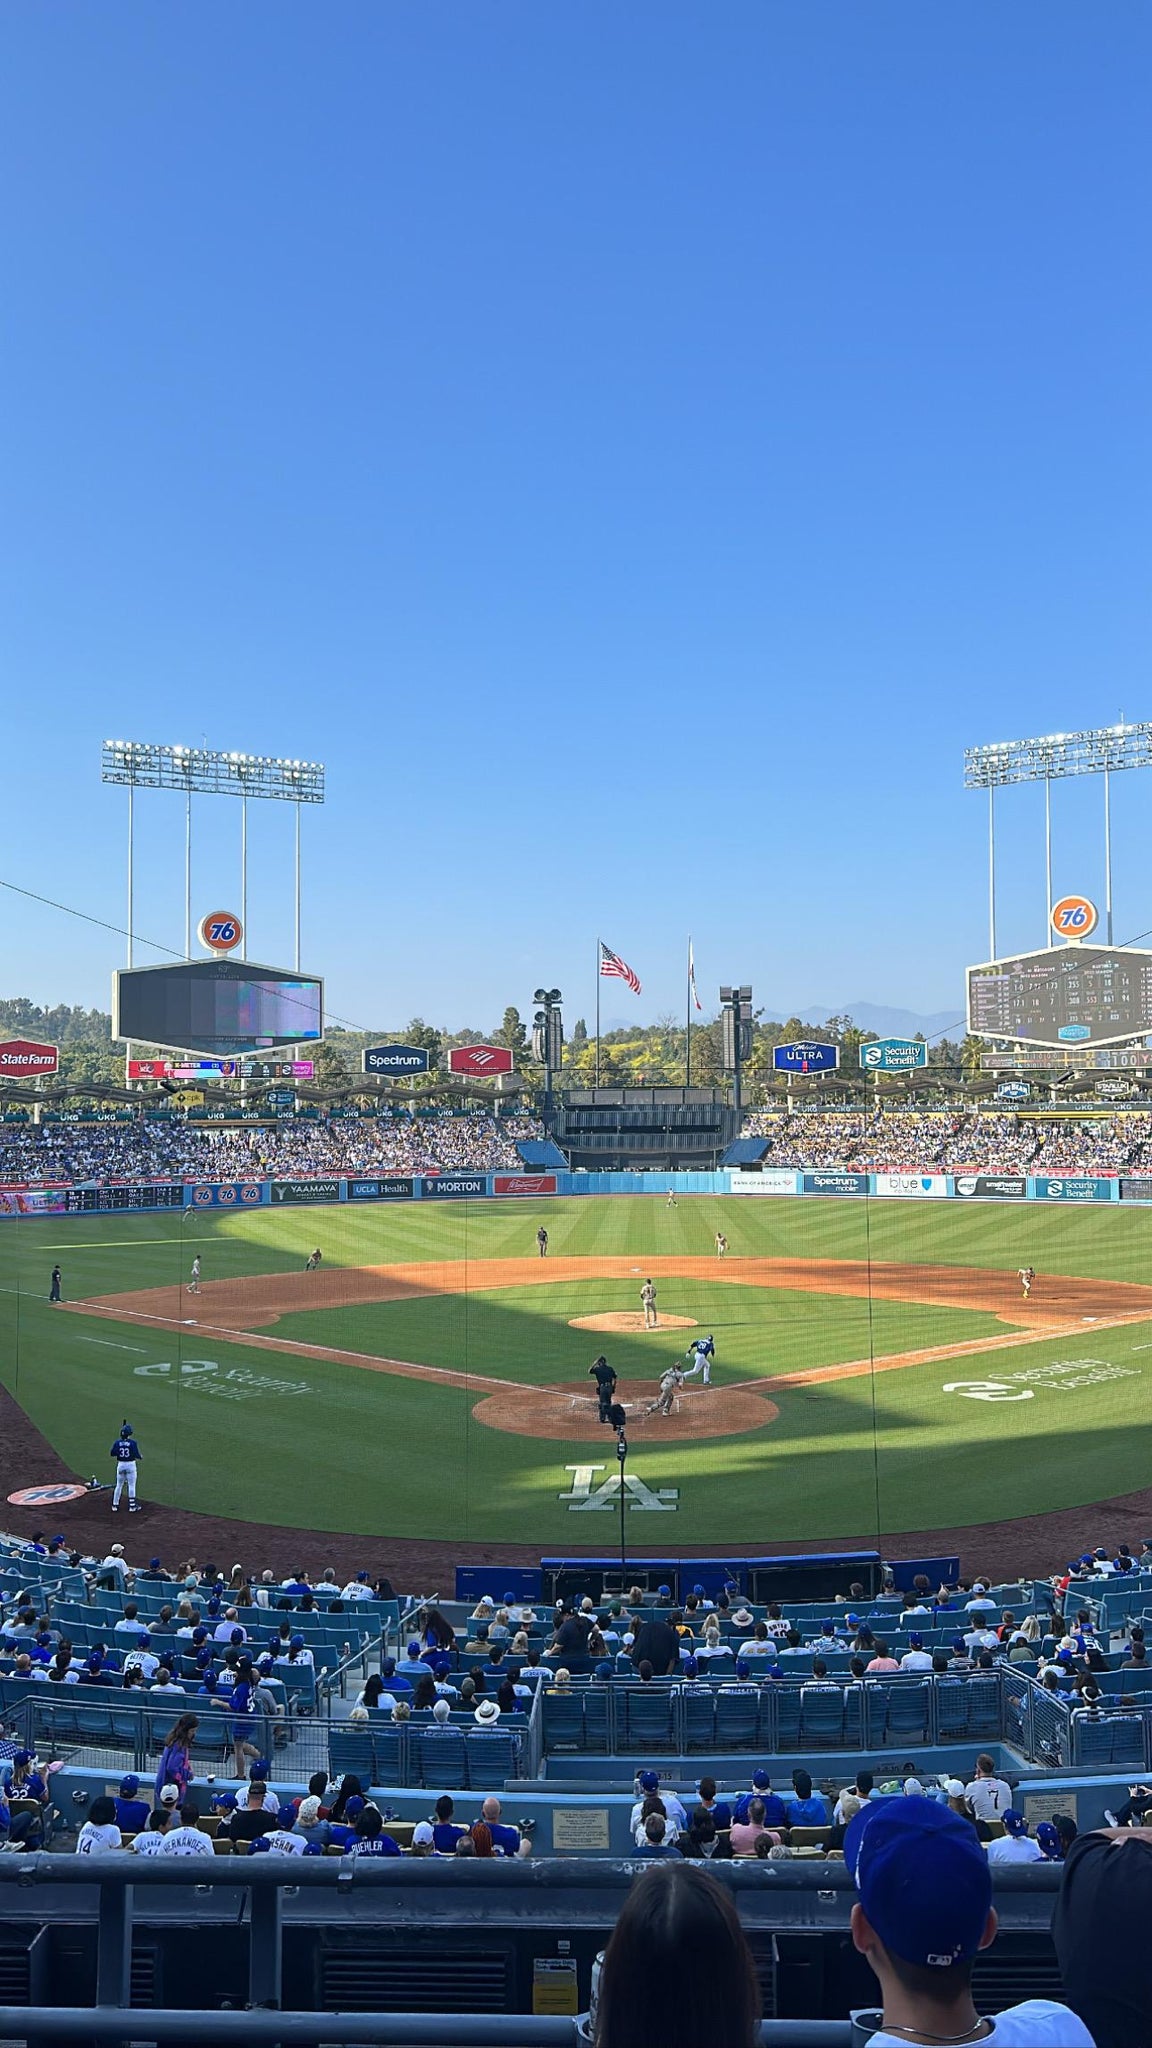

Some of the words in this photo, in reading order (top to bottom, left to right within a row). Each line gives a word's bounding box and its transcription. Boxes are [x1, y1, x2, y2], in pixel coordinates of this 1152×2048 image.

[1060, 906, 1087, 928] 76
[210, 921, 235, 942] 76
[786, 1051, 823, 1060] ULTRA
[885, 1046, 920, 1056] Security
[369, 1055, 420, 1068] Spectrum
[885, 1056, 916, 1065] Benefit
[1113, 1055, 1137, 1066] 100
[438, 1182, 480, 1192] MORTON
[814, 1176, 856, 1187] Spectrum
[890, 1177, 918, 1188] blue
[1065, 1181, 1098, 1190] Security
[221, 1189, 233, 1198] 76
[244, 1188, 256, 1198] 76
[381, 1184, 408, 1193] Health
[1066, 1189, 1094, 1198] Benefit
[197, 1190, 209, 1199] 76
[988, 1358, 1111, 1383] Security
[1030, 1366, 1142, 1390] Benefit
[119, 1447, 130, 1458] 33
[558, 1465, 678, 1511] LA
[22, 1486, 76, 1502] 76
[988, 1790, 1000, 1810] 7
[79, 1838, 93, 1854] 14
[269, 1837, 296, 1853] RSHAW
[352, 1841, 383, 1854] BUEHLER
